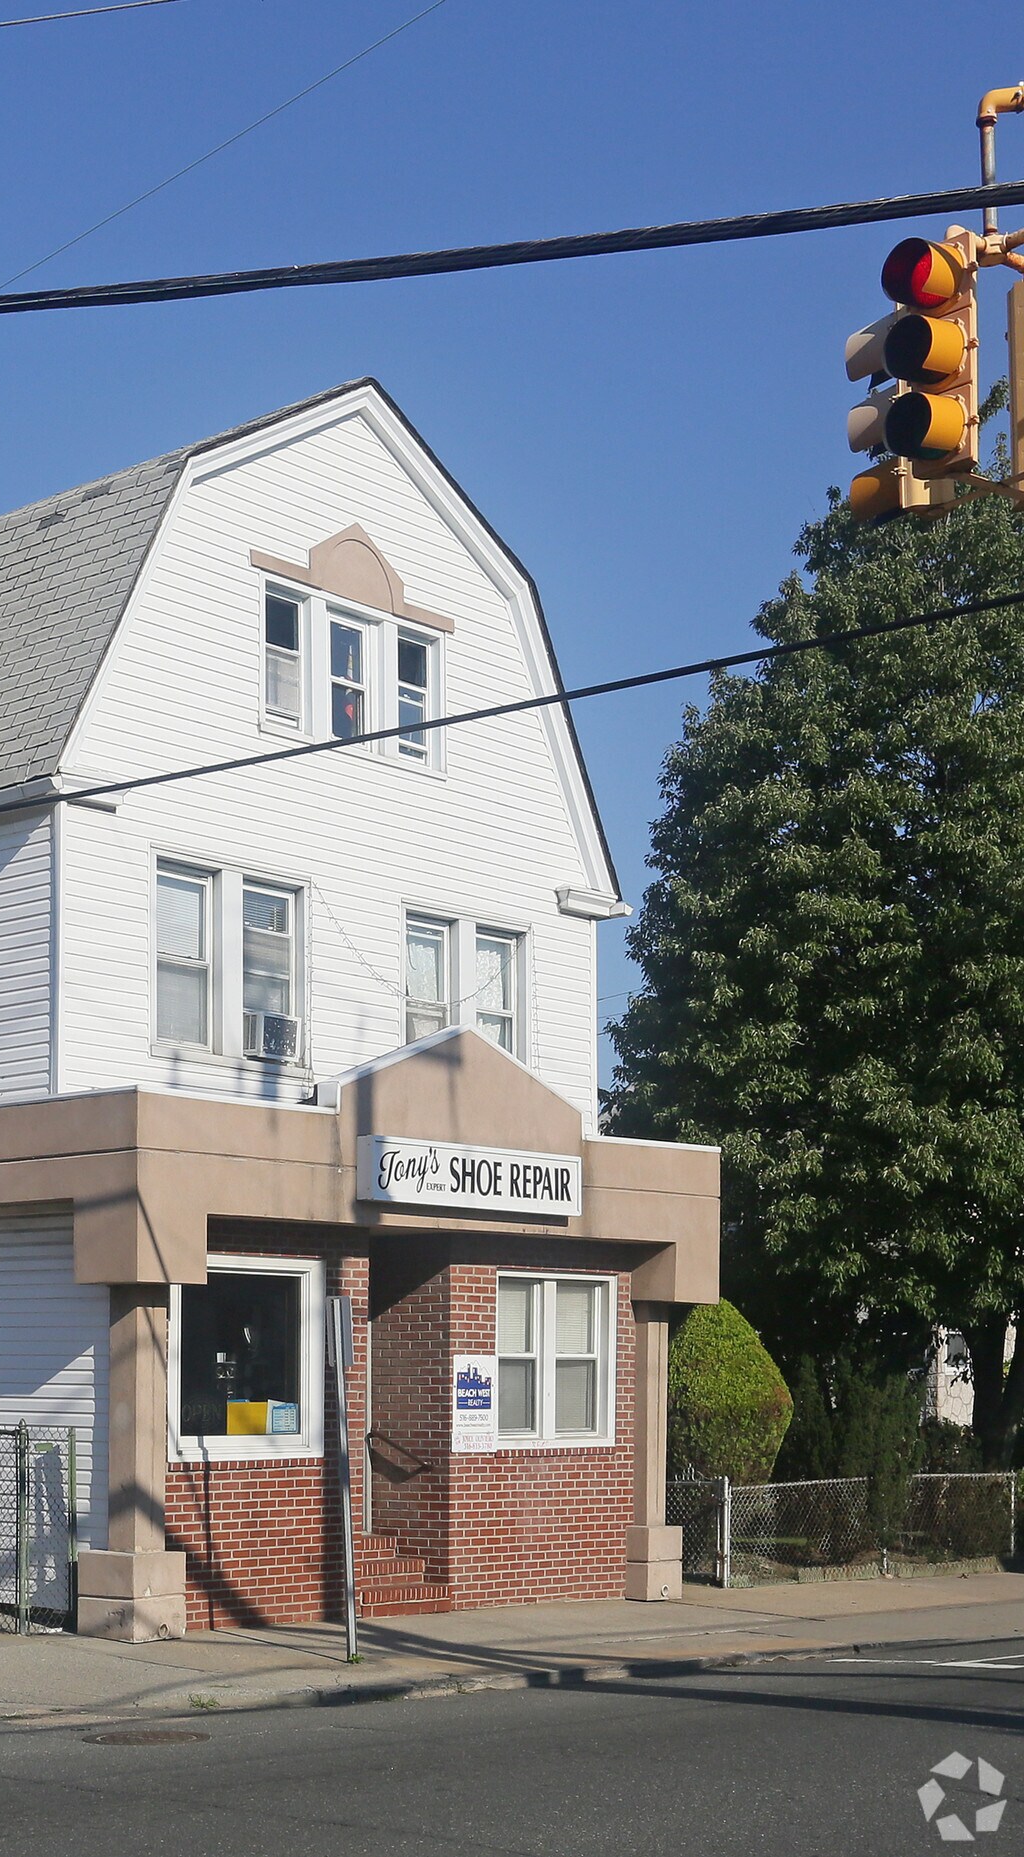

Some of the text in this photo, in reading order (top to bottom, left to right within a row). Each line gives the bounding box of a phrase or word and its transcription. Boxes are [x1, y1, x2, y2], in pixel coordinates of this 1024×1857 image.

[378, 1147, 440, 1193] Tony's
[449, 1156, 572, 1202] SHOE REPAIR
[426, 1182, 447, 1192] EXPERT
[457, 1388, 490, 1398] BEACH WEST
[468, 1398, 484, 1406] REALTY
